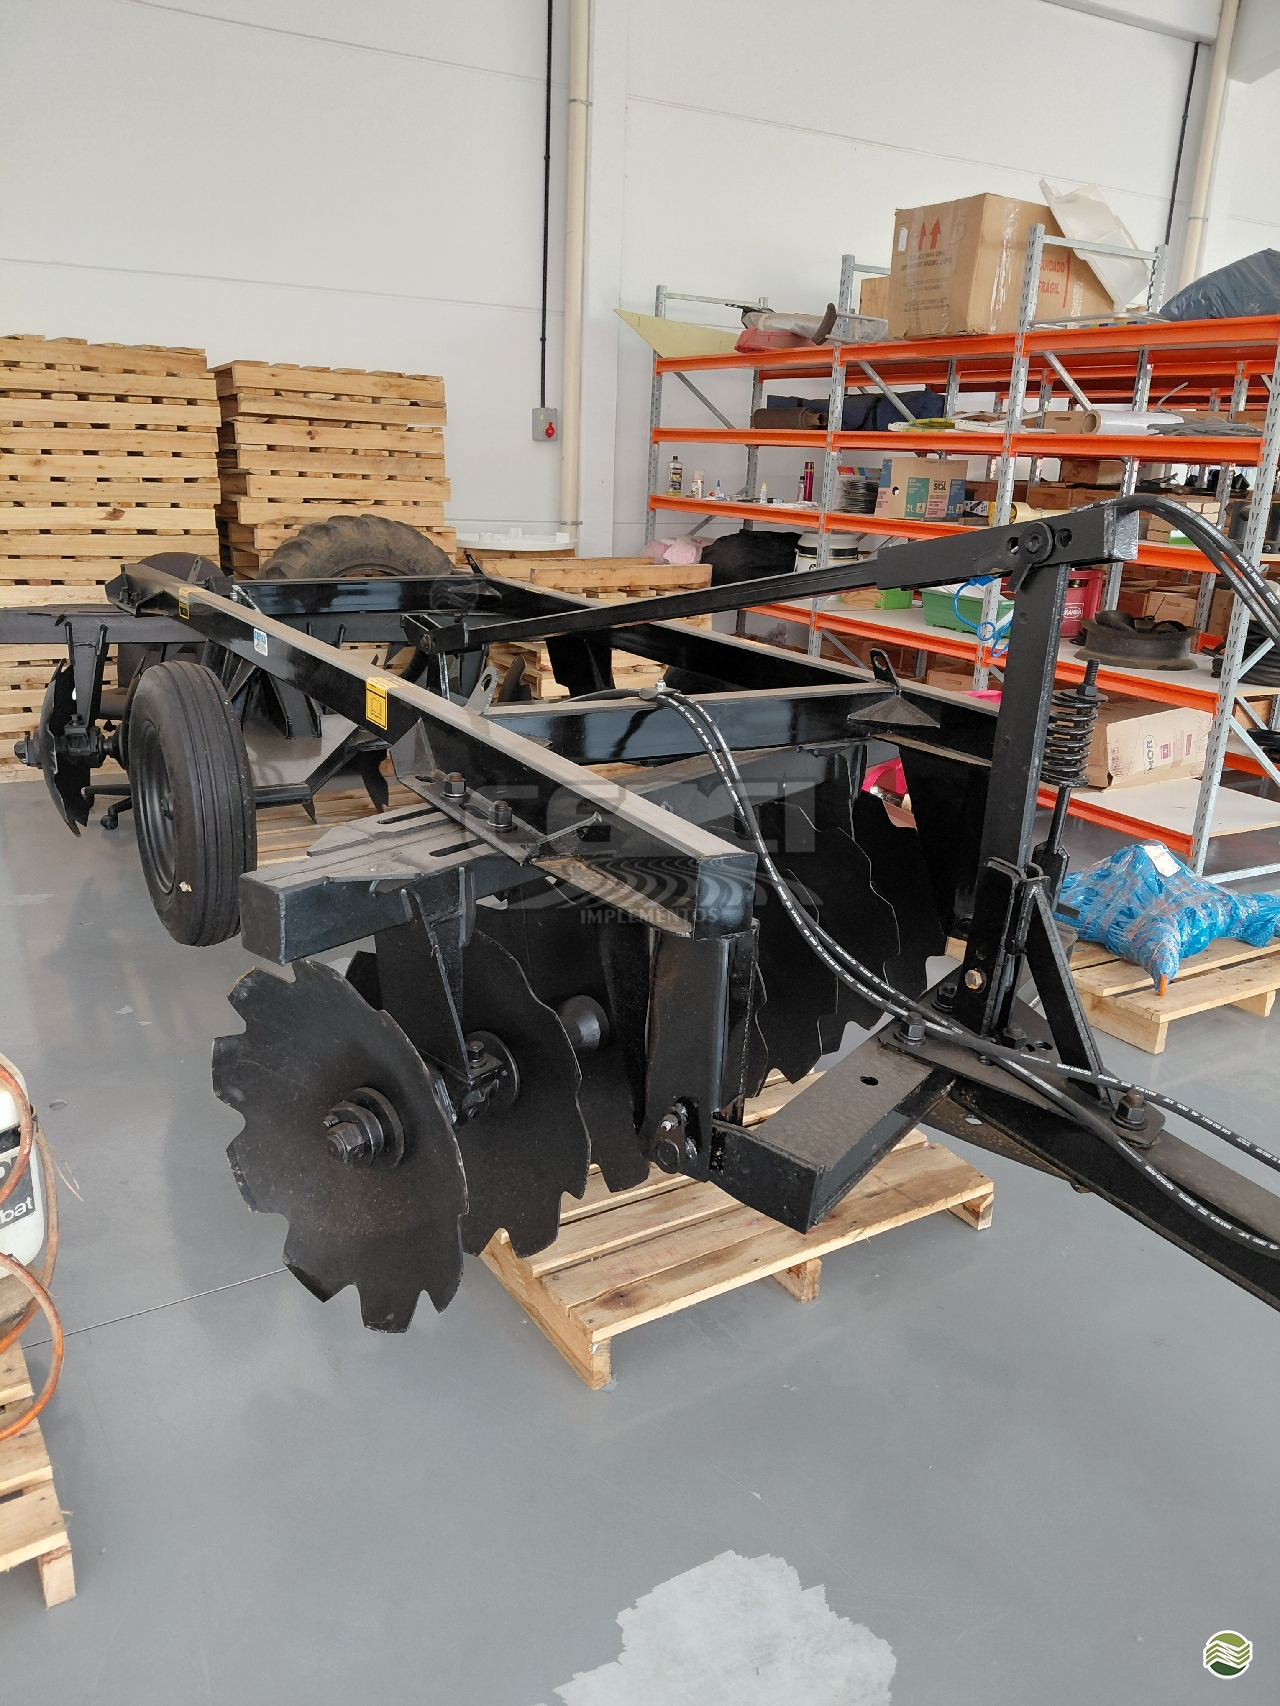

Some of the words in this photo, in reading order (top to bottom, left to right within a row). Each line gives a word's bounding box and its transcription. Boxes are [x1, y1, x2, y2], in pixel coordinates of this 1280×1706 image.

[906, 503, 914, 512] 2L
[1146, 739, 1155, 772] MOR
[0, 1196, 33, 1225] bat
